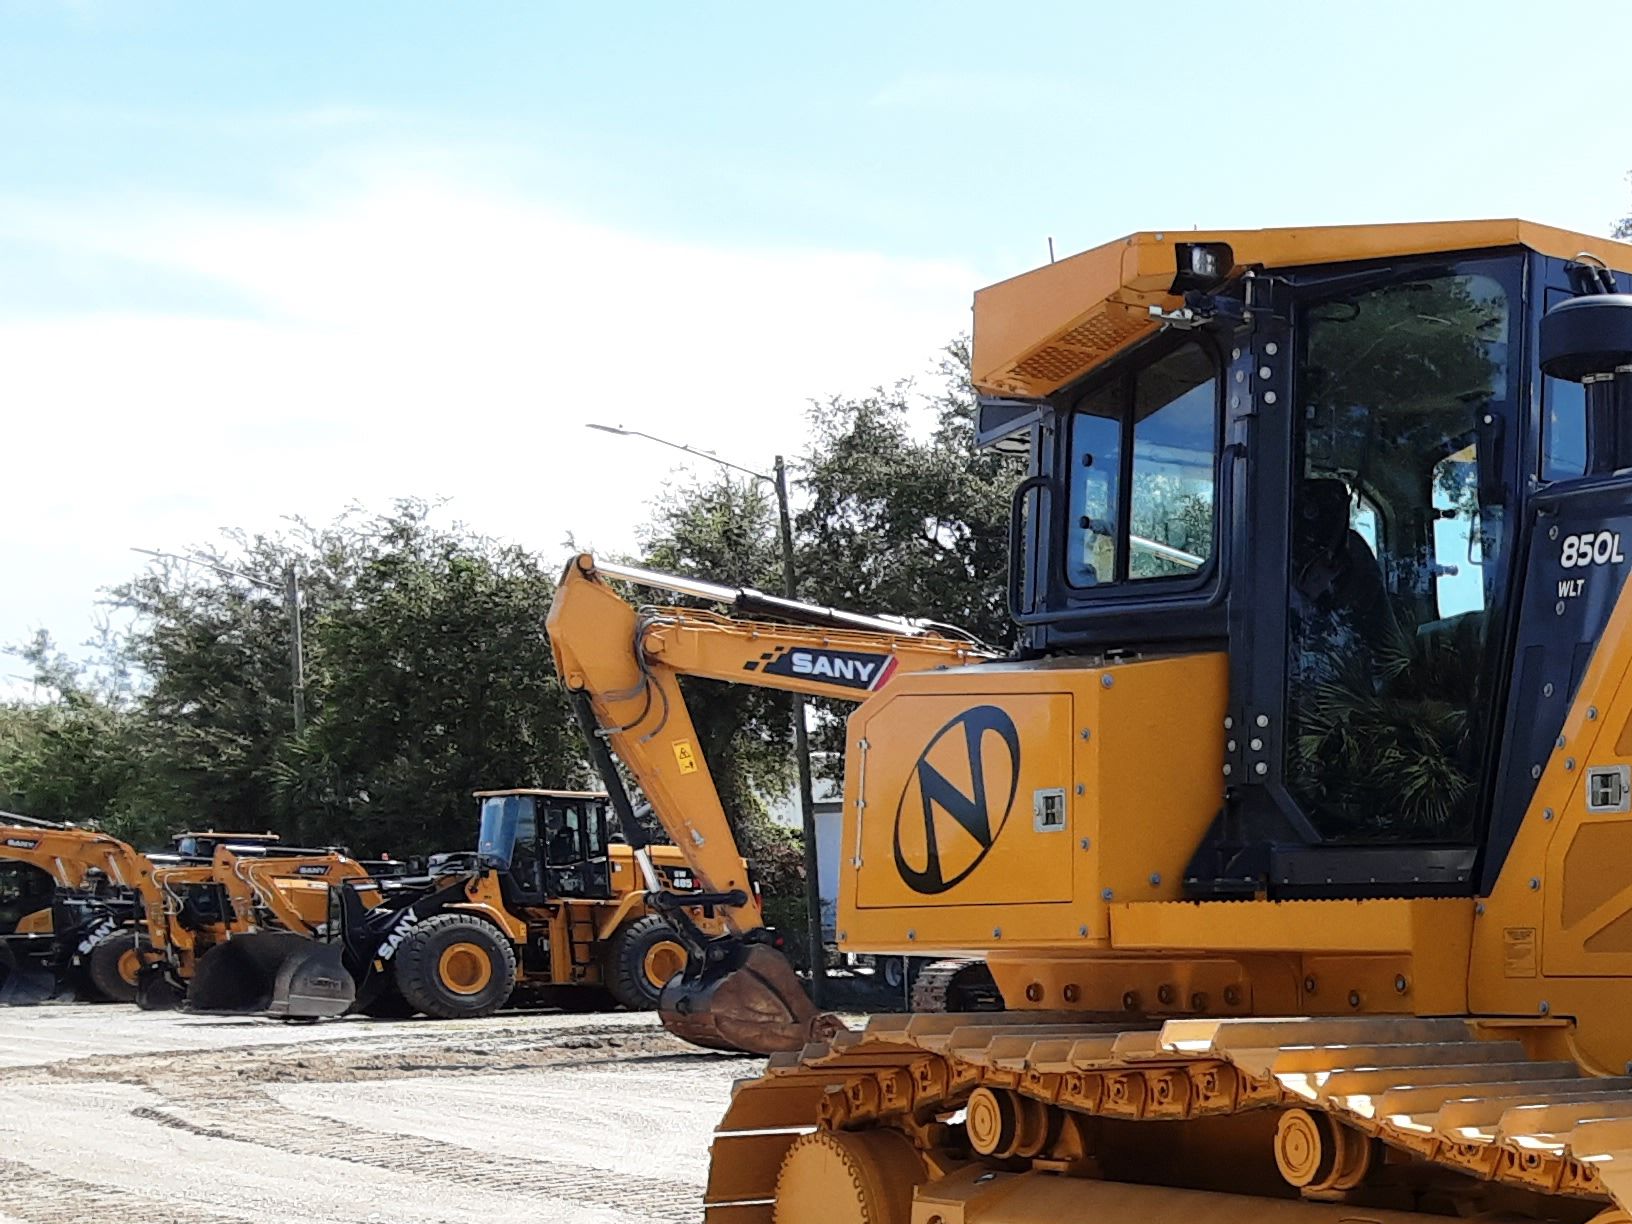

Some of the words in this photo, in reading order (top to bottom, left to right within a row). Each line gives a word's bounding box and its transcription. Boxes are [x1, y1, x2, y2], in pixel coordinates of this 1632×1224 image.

[1561, 531, 1624, 568] 850L
[1558, 579, 1585, 598] WLT
[791, 652, 875, 682] SANY
[378, 907, 418, 960] SANY
